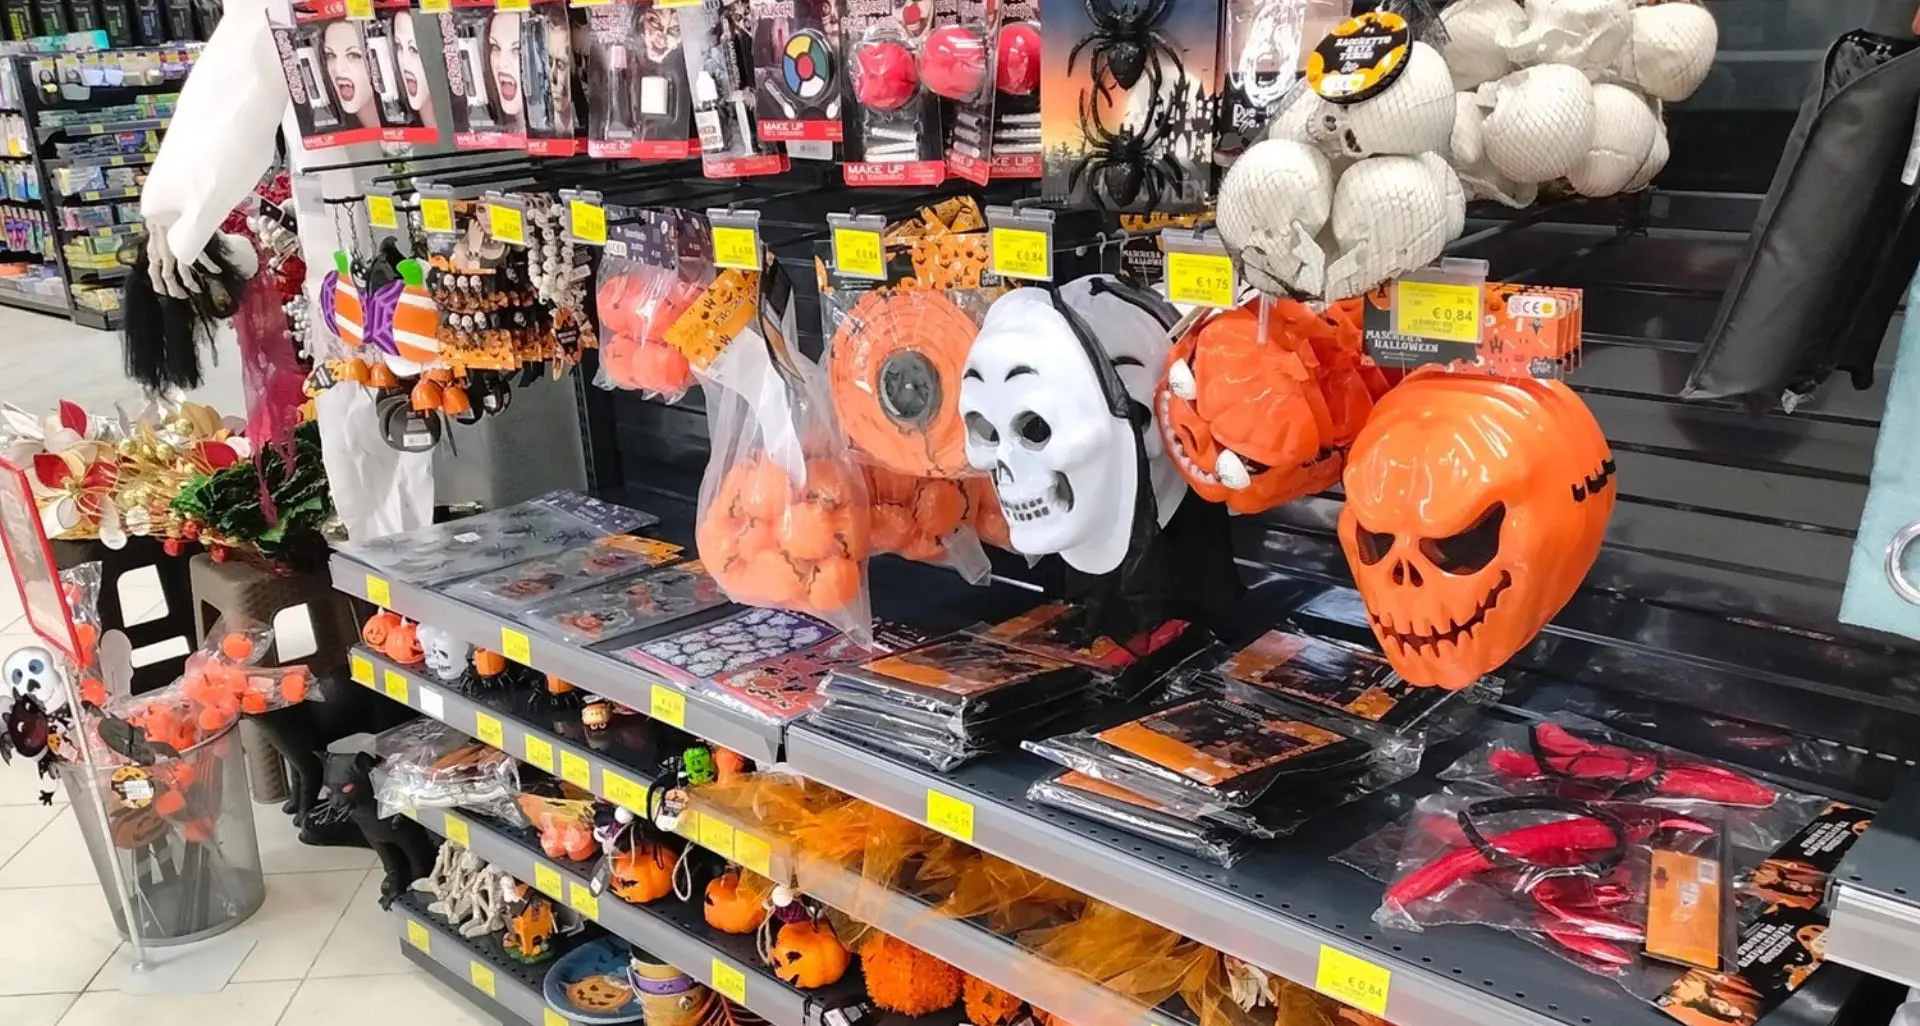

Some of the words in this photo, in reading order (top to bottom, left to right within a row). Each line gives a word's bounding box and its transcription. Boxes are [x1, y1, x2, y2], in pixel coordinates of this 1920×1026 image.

[763, 121, 786, 131] MAKE
[791, 121, 804, 131] UP
[1015, 157, 1035, 167] UP
[848, 165, 883, 175] MAKE
[887, 164, 905, 174] UP
[1444, 308, 1473, 323] 0,84
[1374, 340, 1440, 353] HALLOWEEN
